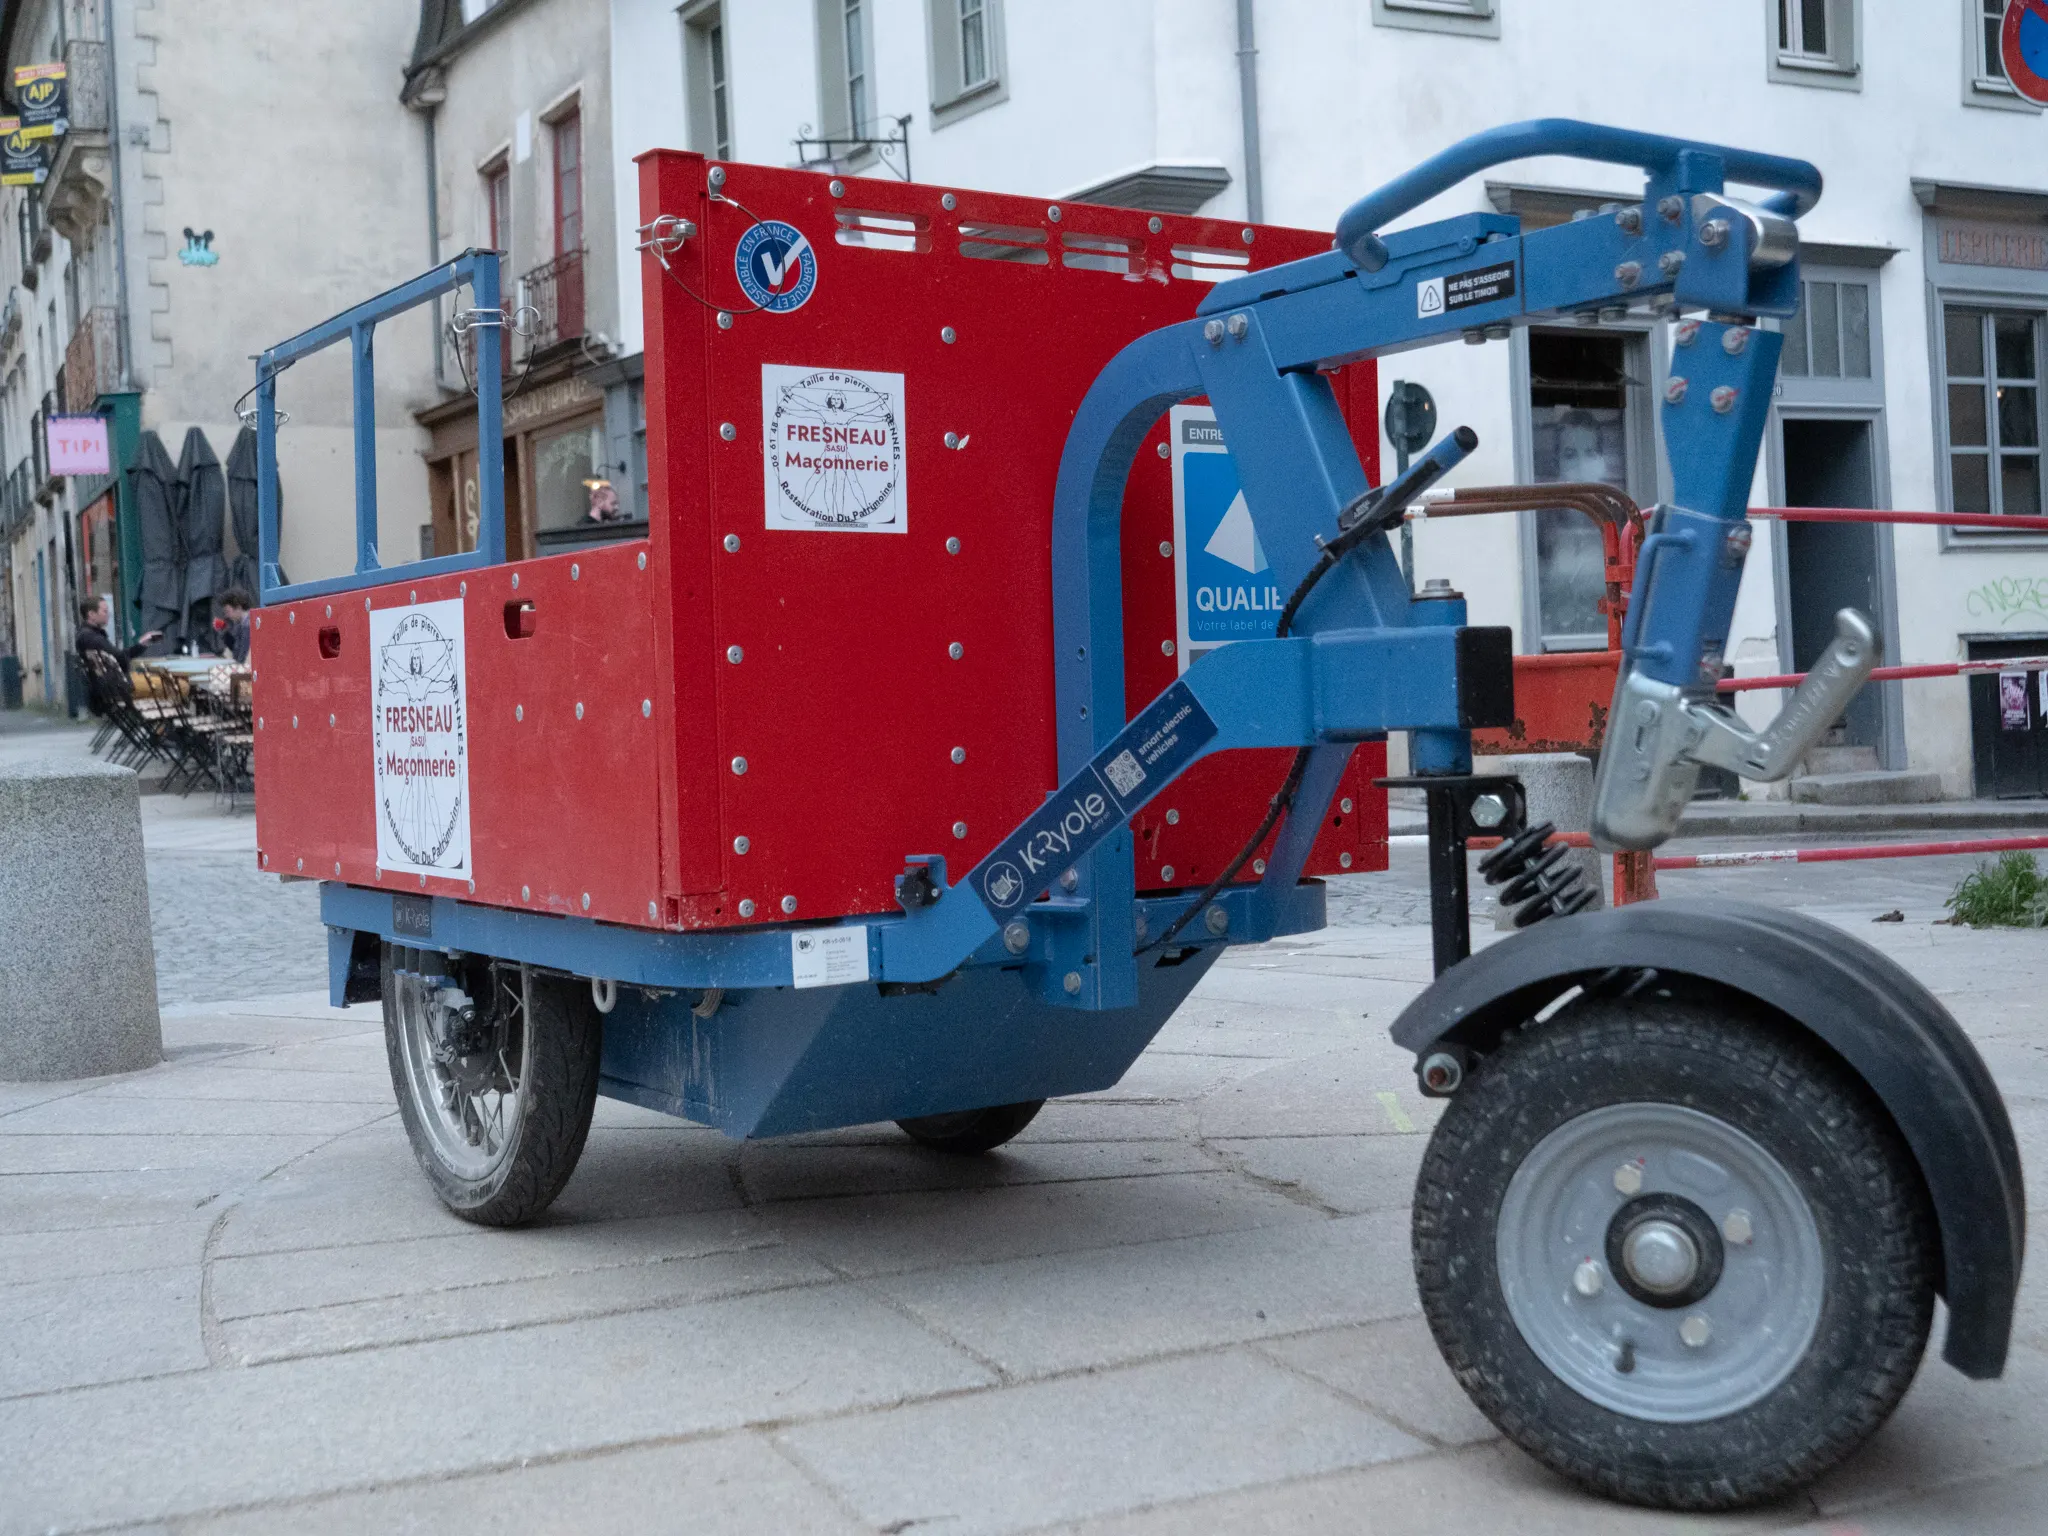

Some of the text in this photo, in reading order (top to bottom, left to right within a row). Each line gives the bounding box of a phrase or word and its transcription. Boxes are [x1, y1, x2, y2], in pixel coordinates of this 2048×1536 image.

[29, 82, 54, 102] AJP
[742, 236, 756, 252] EN
[1448, 270, 1511, 292] NE PAS S'ASSEOIR
[775, 298, 789, 308] ET
[1449, 285, 1499, 305] SUR LE TIMON
[800, 373, 870, 392] Taille de pierre
[771, 421, 778, 434] 48
[787, 424, 886, 446] FRESNEAU
[884, 413, 901, 460] RENNES
[58, 439, 100, 454] TIPI
[770, 439, 776, 450] 61
[826, 445, 846, 453] SASU
[771, 455, 780, 467] 06
[785, 451, 889, 474] Maçonnerie
[780, 481, 893, 523] Restauration Du Patrimoine
[393, 620, 408, 645] Taille
[421, 616, 440, 640] pierre
[1197, 620, 1274, 631] Votre label de
[386, 705, 452, 733] FRESNEAU
[1139, 705, 1192, 755] smart electric
[411, 736, 425, 747] SASU
[1145, 734, 1178, 765] vehicles
[386, 749, 455, 785] Maçonnerie
[384, 797, 460, 865] Restauration Du Patrimoine
